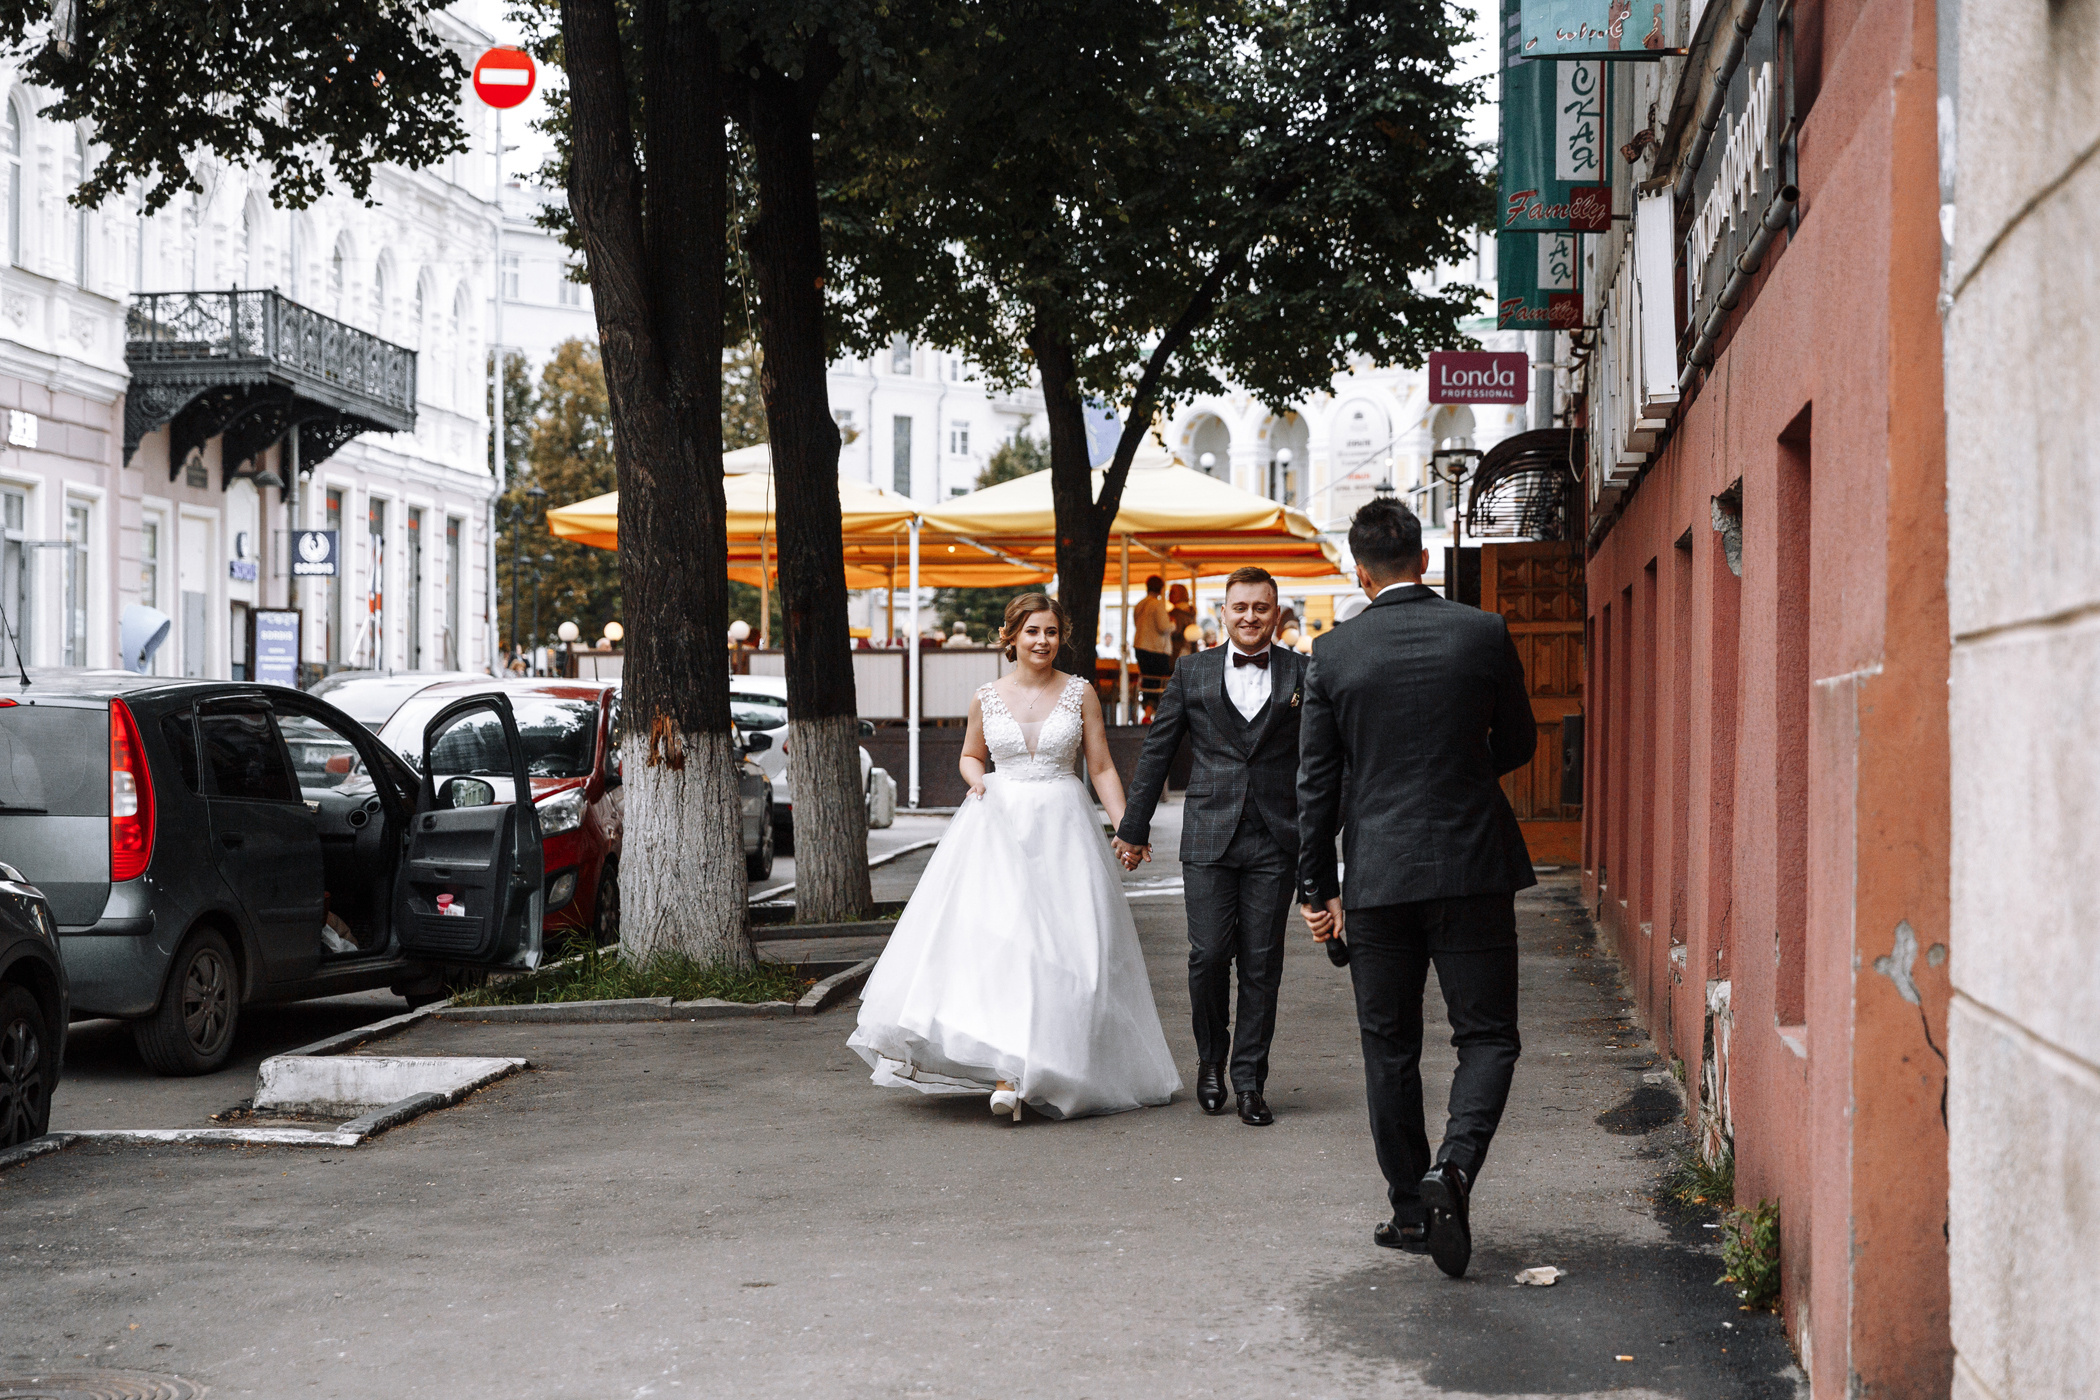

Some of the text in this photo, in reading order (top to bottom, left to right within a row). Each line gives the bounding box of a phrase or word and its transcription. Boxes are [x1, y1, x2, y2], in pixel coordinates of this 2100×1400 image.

[1564, 60, 1602, 173] СКАЯ
[1505, 189, 1606, 228] Family
[1548, 232, 1574, 285] АЯ
[1499, 297, 1579, 328] Family
[1441, 359, 1515, 387] Londa
[1441, 389, 1515, 398] PROFESSIONAL
